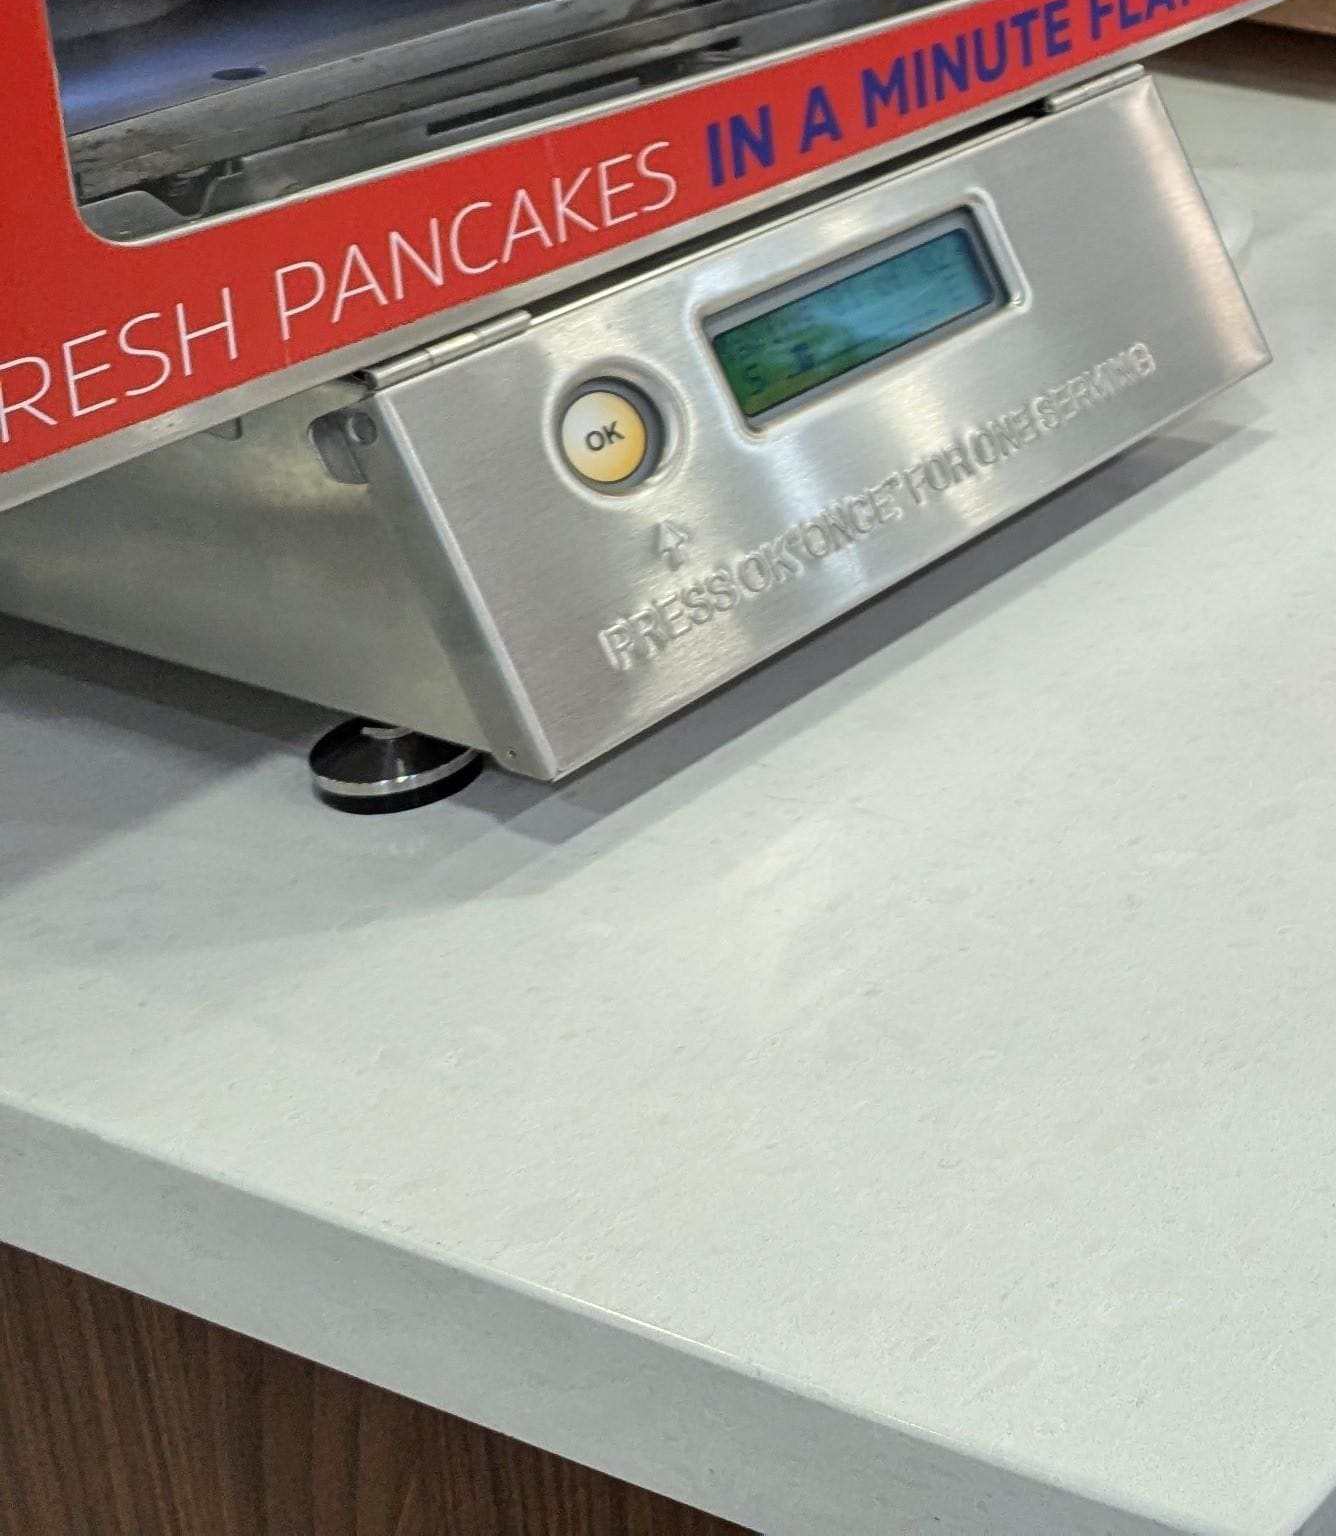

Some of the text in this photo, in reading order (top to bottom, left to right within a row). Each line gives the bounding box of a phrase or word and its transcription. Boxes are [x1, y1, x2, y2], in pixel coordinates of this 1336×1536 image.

[273, 141, 679, 341] PANCAKES
[706, 104, 775, 187] IN
[799, 85, 843, 154] A
[585, 420, 626, 452] OK
[597, 565, 741, 672] PRESS
[737, 534, 804, 593] OK
[902, 444, 972, 506] FOR
[965, 407, 1042, 469] ONE
[1031, 342, 1156, 433] SERVING
